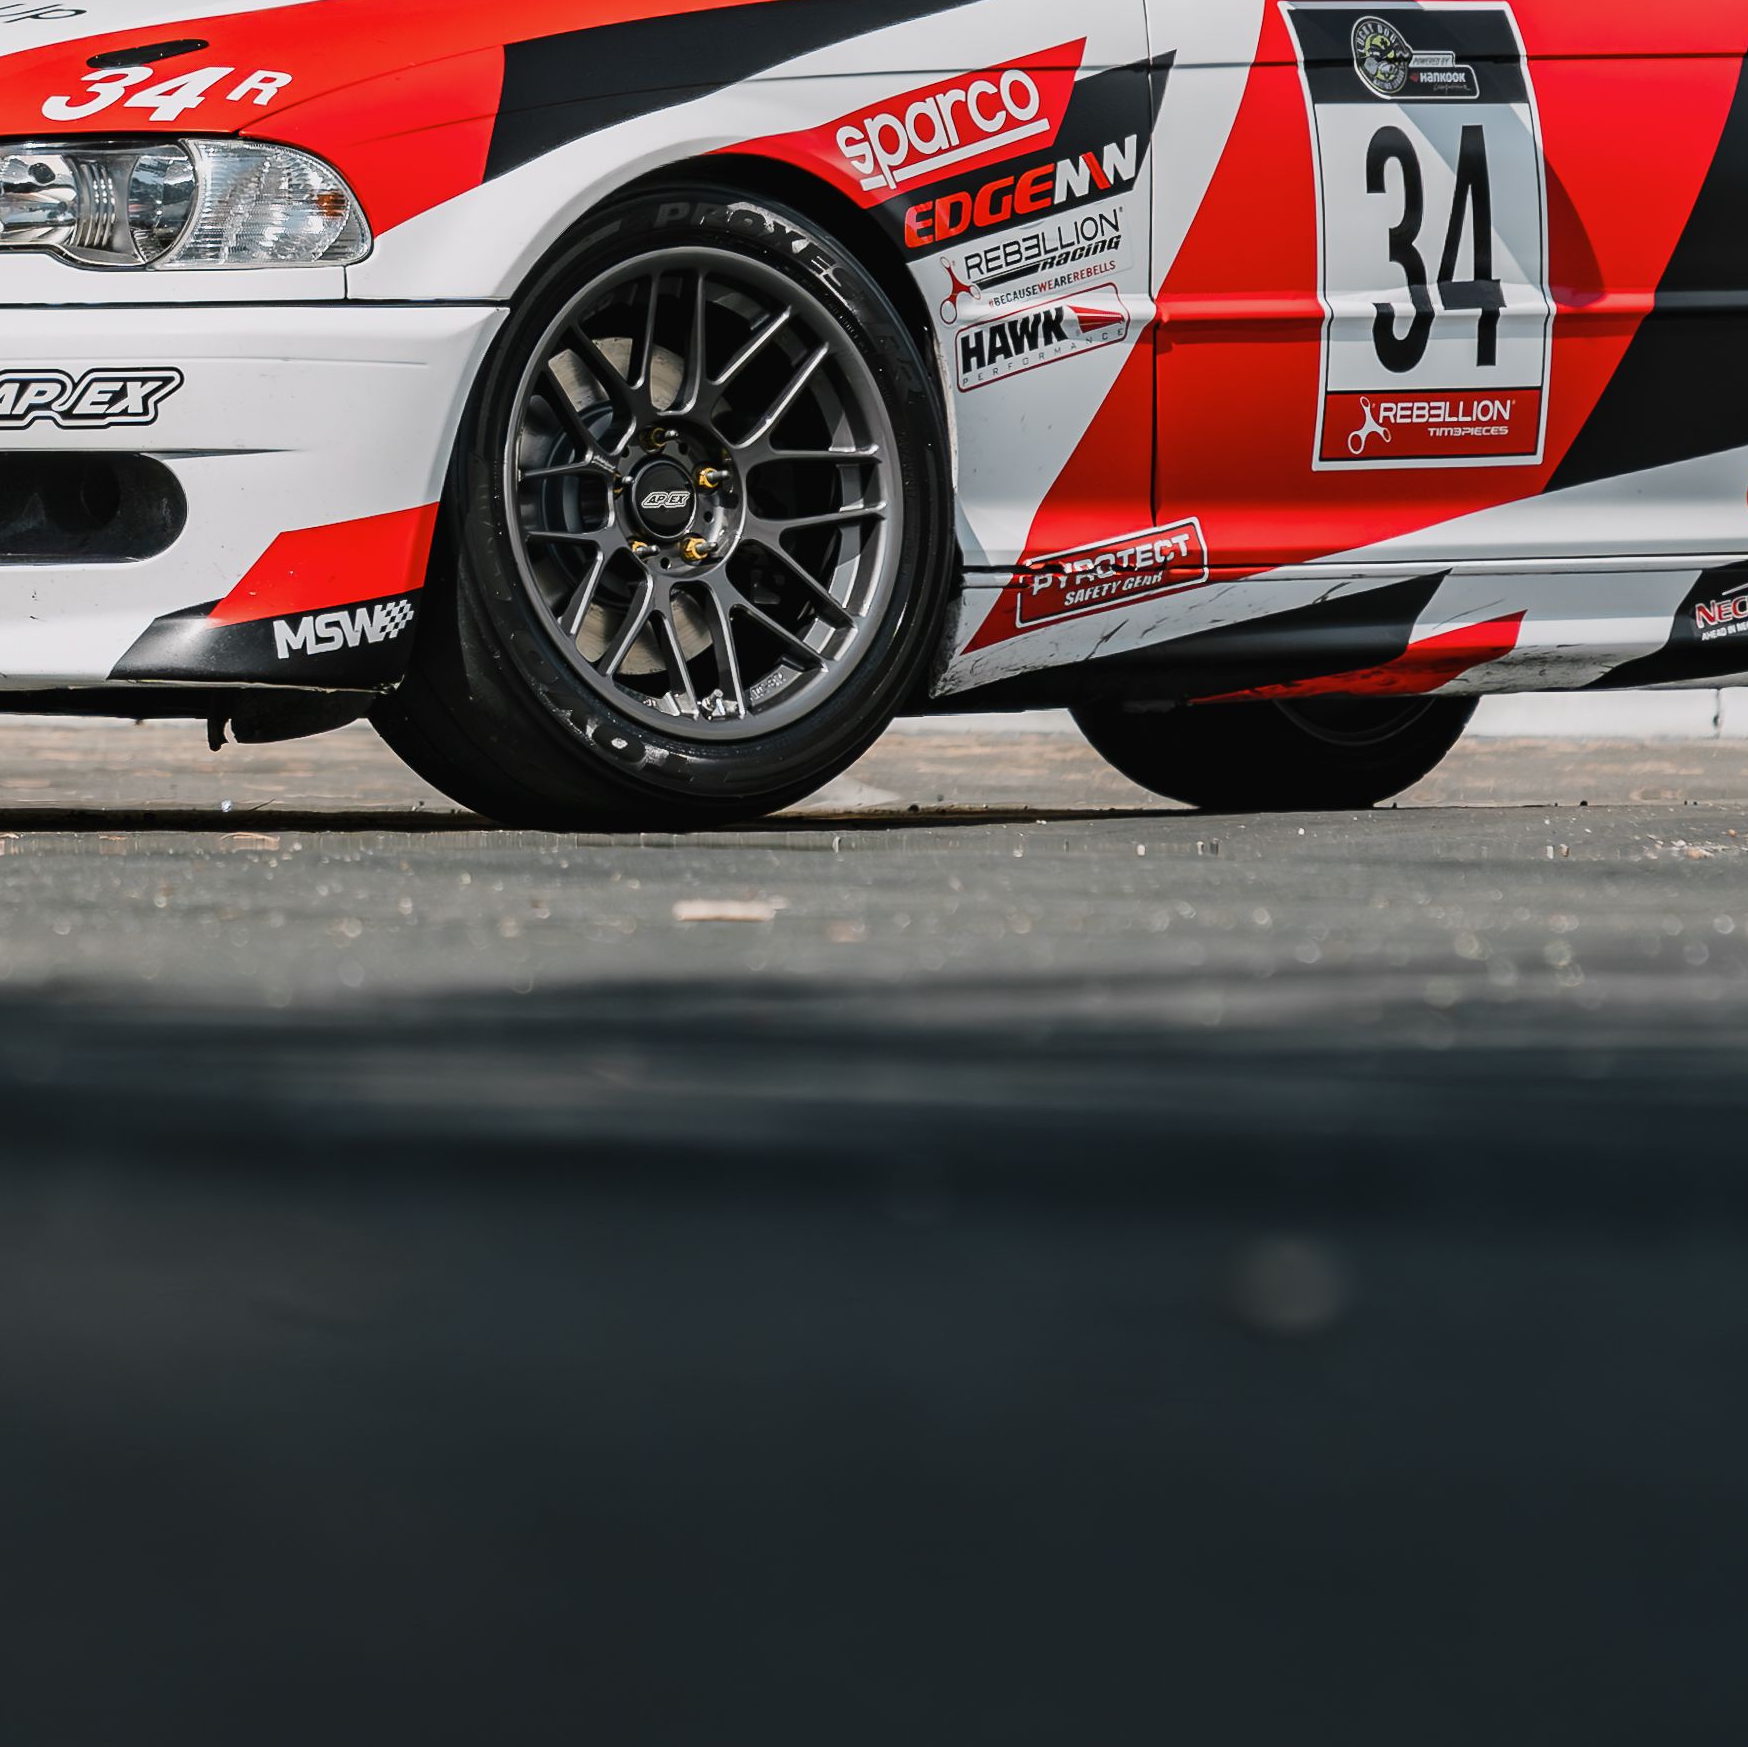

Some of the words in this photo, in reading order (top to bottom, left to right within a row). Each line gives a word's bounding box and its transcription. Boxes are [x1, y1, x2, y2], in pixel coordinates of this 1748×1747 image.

[41, 66, 236, 121] 34
[225, 69, 293, 106] R
[836, 69, 1041, 190] sparco
[964, 209, 1121, 280] REBELLION
[1365, 123, 1508, 373] 34
[960, 305, 1069, 375] HAWK
[962, 328, 1124, 387] PERFORMANCE
[1379, 399, 1511, 424] REBELLION
[645, 494, 687, 505] APEX
[1064, 580, 1122, 607] SAFETY
[272, 604, 384, 660] MSW
[1701, 627, 1727, 641] AHEAD
[1727, 623, 1737, 635] IN
